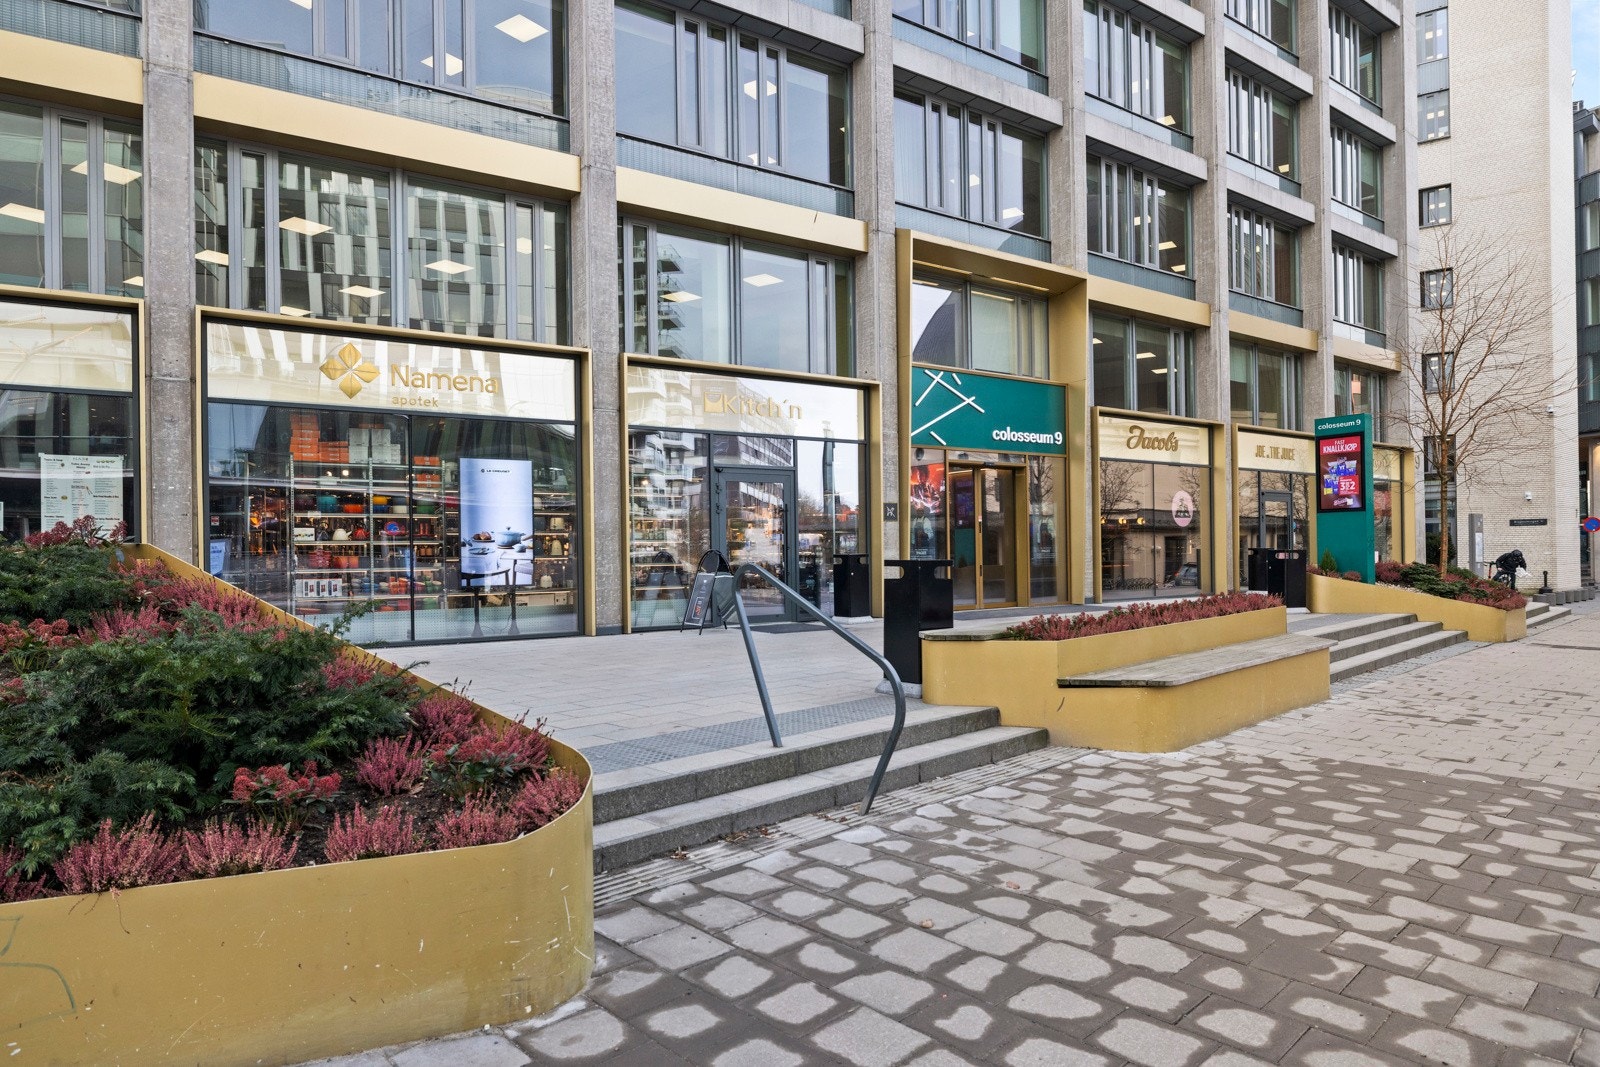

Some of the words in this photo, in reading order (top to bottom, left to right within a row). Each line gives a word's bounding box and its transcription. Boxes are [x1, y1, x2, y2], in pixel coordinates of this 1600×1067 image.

[390, 363, 499, 394] Namena
[391, 394, 439, 408] apotek
[1317, 420, 1355, 431] colosseum
[1355, 418, 1361, 426] 9
[992, 426, 1054, 444] colosseum
[1054, 431, 1063, 445] 9
[1126, 425, 1179, 452] Jacob's
[1323, 443, 1358, 454] KNALLKJØP
